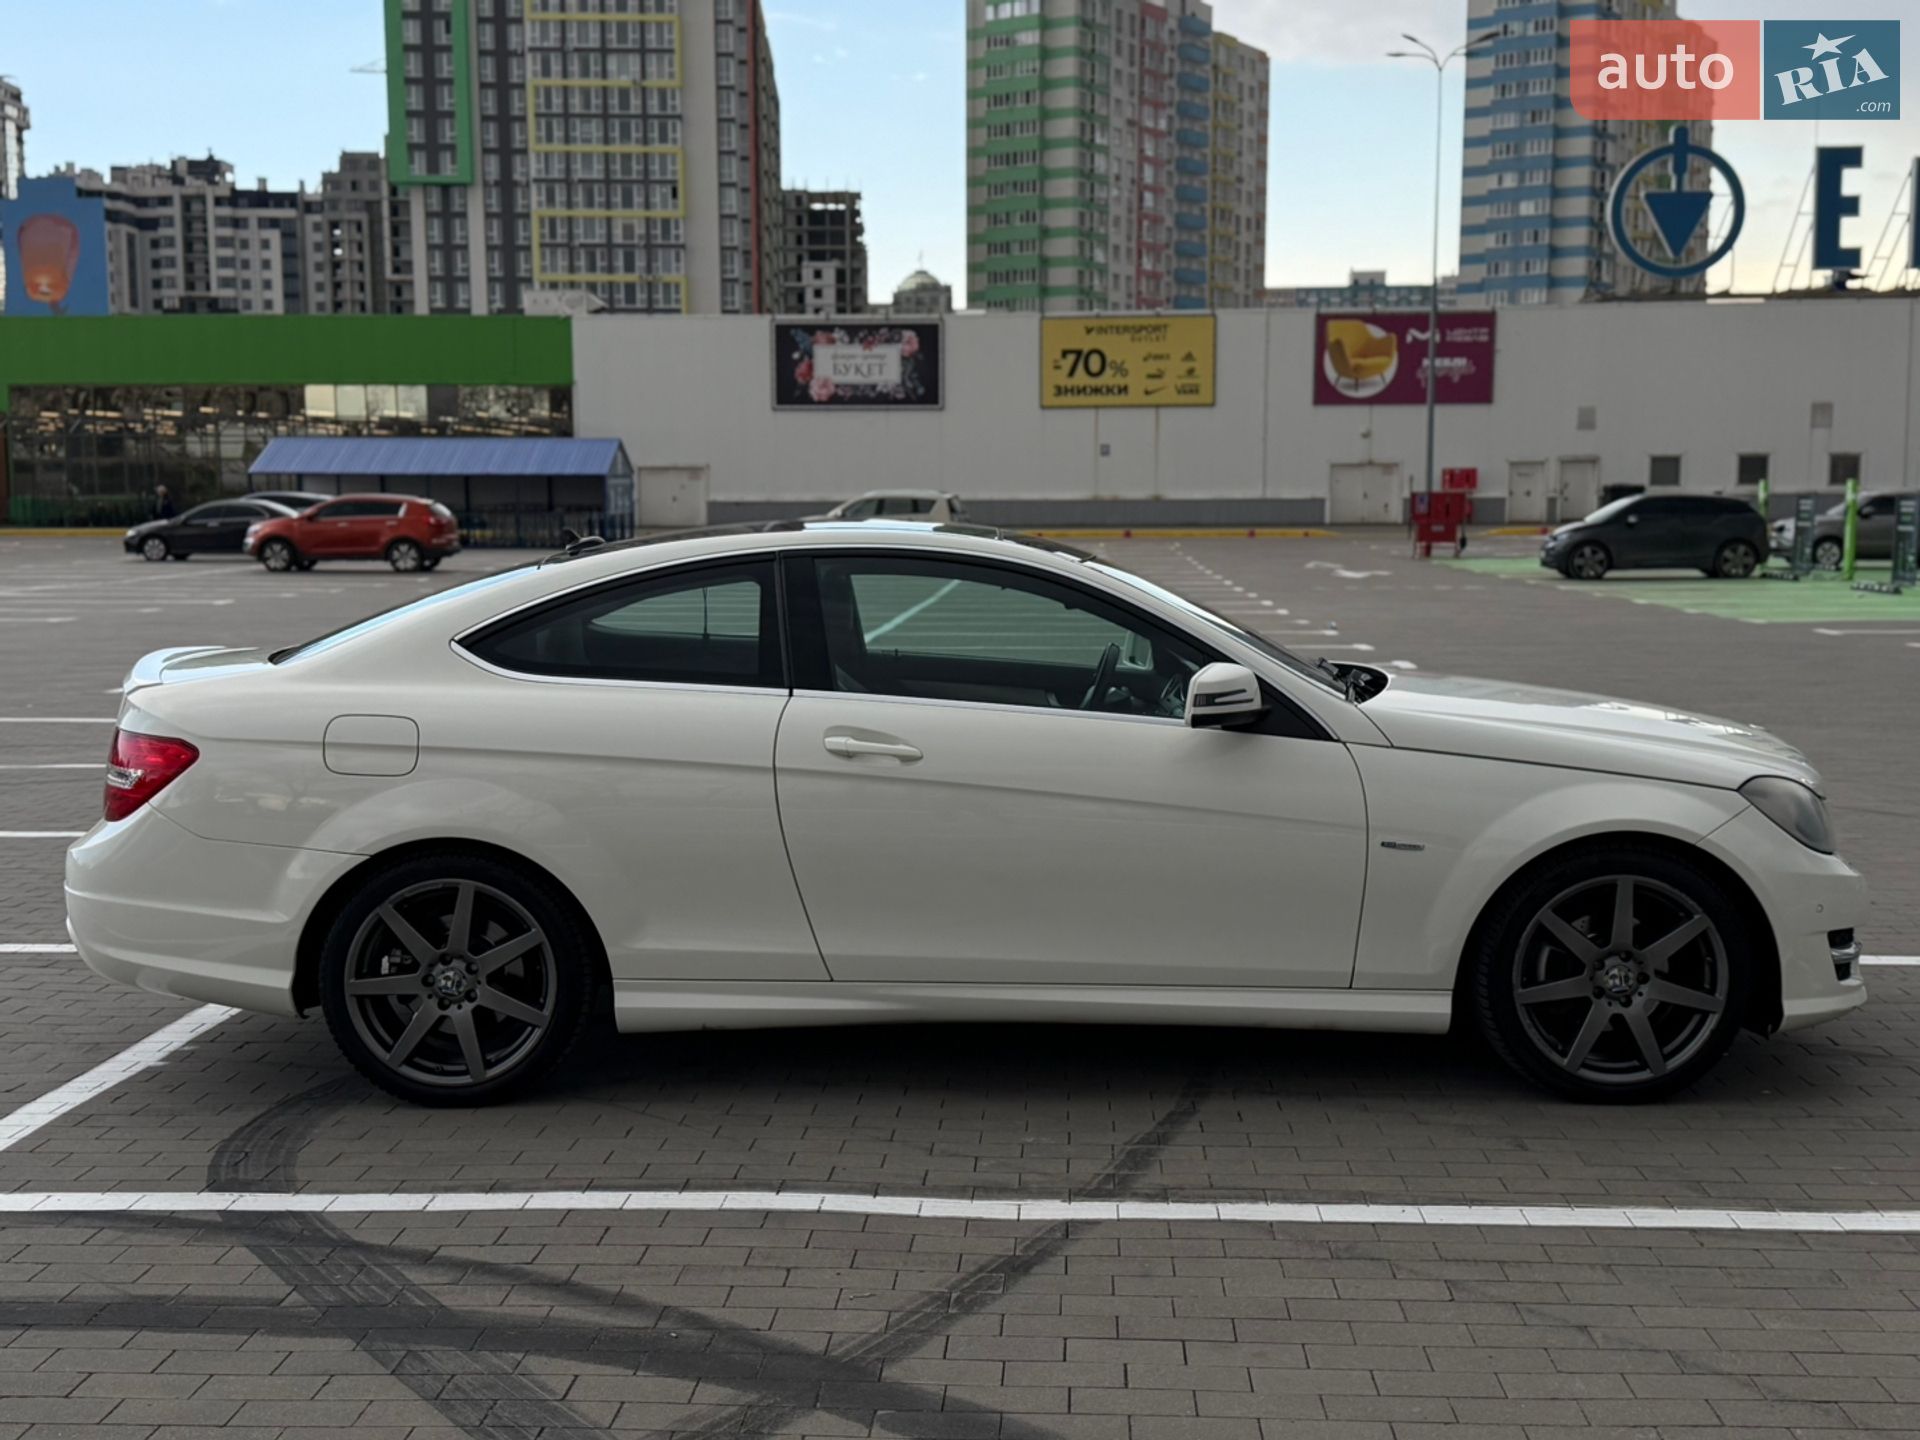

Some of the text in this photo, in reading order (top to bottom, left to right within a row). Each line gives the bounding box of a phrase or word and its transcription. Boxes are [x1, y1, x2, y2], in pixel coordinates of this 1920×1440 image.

[1096, 324, 1168, 335] INTERSPORT
[832, 362, 887, 378] БУКЕТ
[1053, 384, 1128, 397] ЗНИЖКИ
